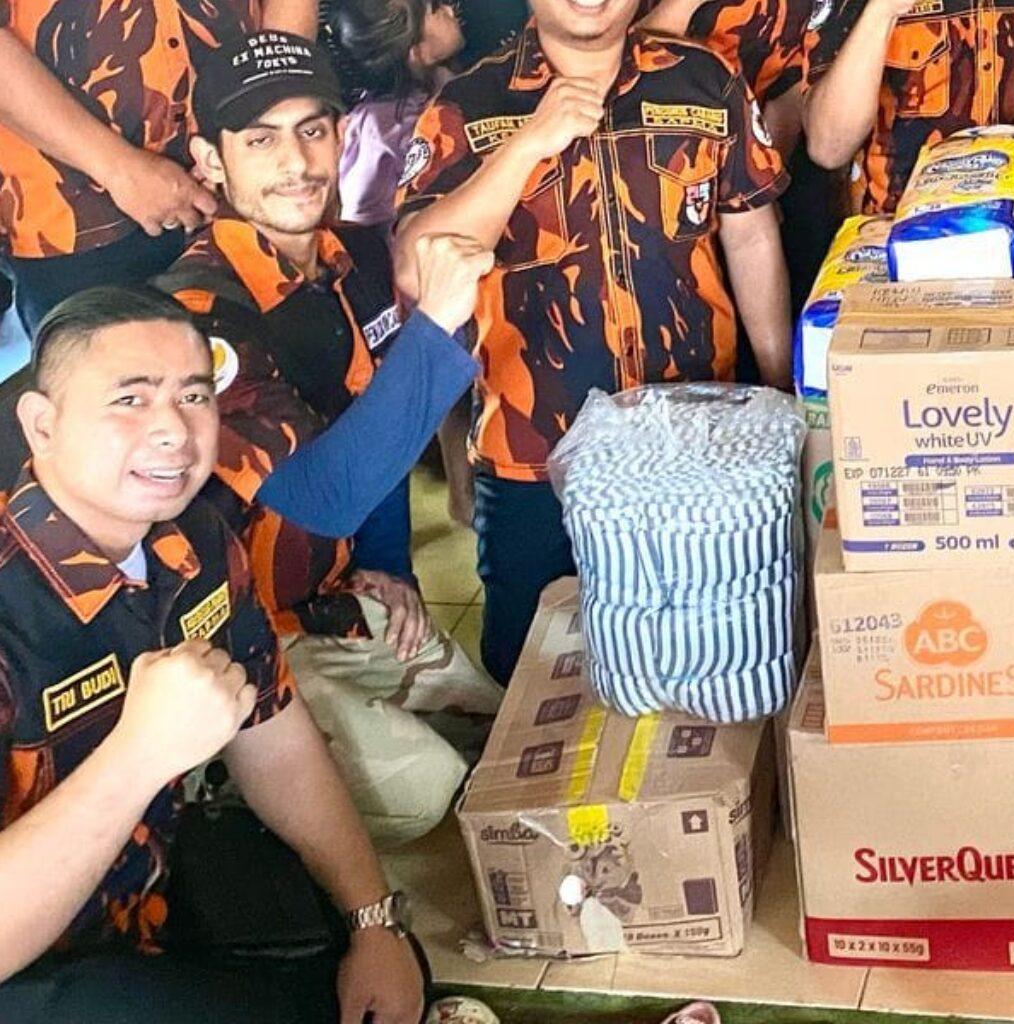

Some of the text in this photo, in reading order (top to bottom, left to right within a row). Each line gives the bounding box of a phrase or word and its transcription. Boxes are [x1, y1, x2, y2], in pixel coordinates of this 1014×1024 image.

[926, 382, 980, 395] emeron
[902, 397, 1013, 438] Lovely
[934, 534, 1000, 550] 500 ml
[913, 628, 984, 655] ABC
[81, 667, 119, 701] BUDI
[834, 939, 848, 951] 10
[858, 940, 866, 951] 2
[878, 941, 889, 953] 10
